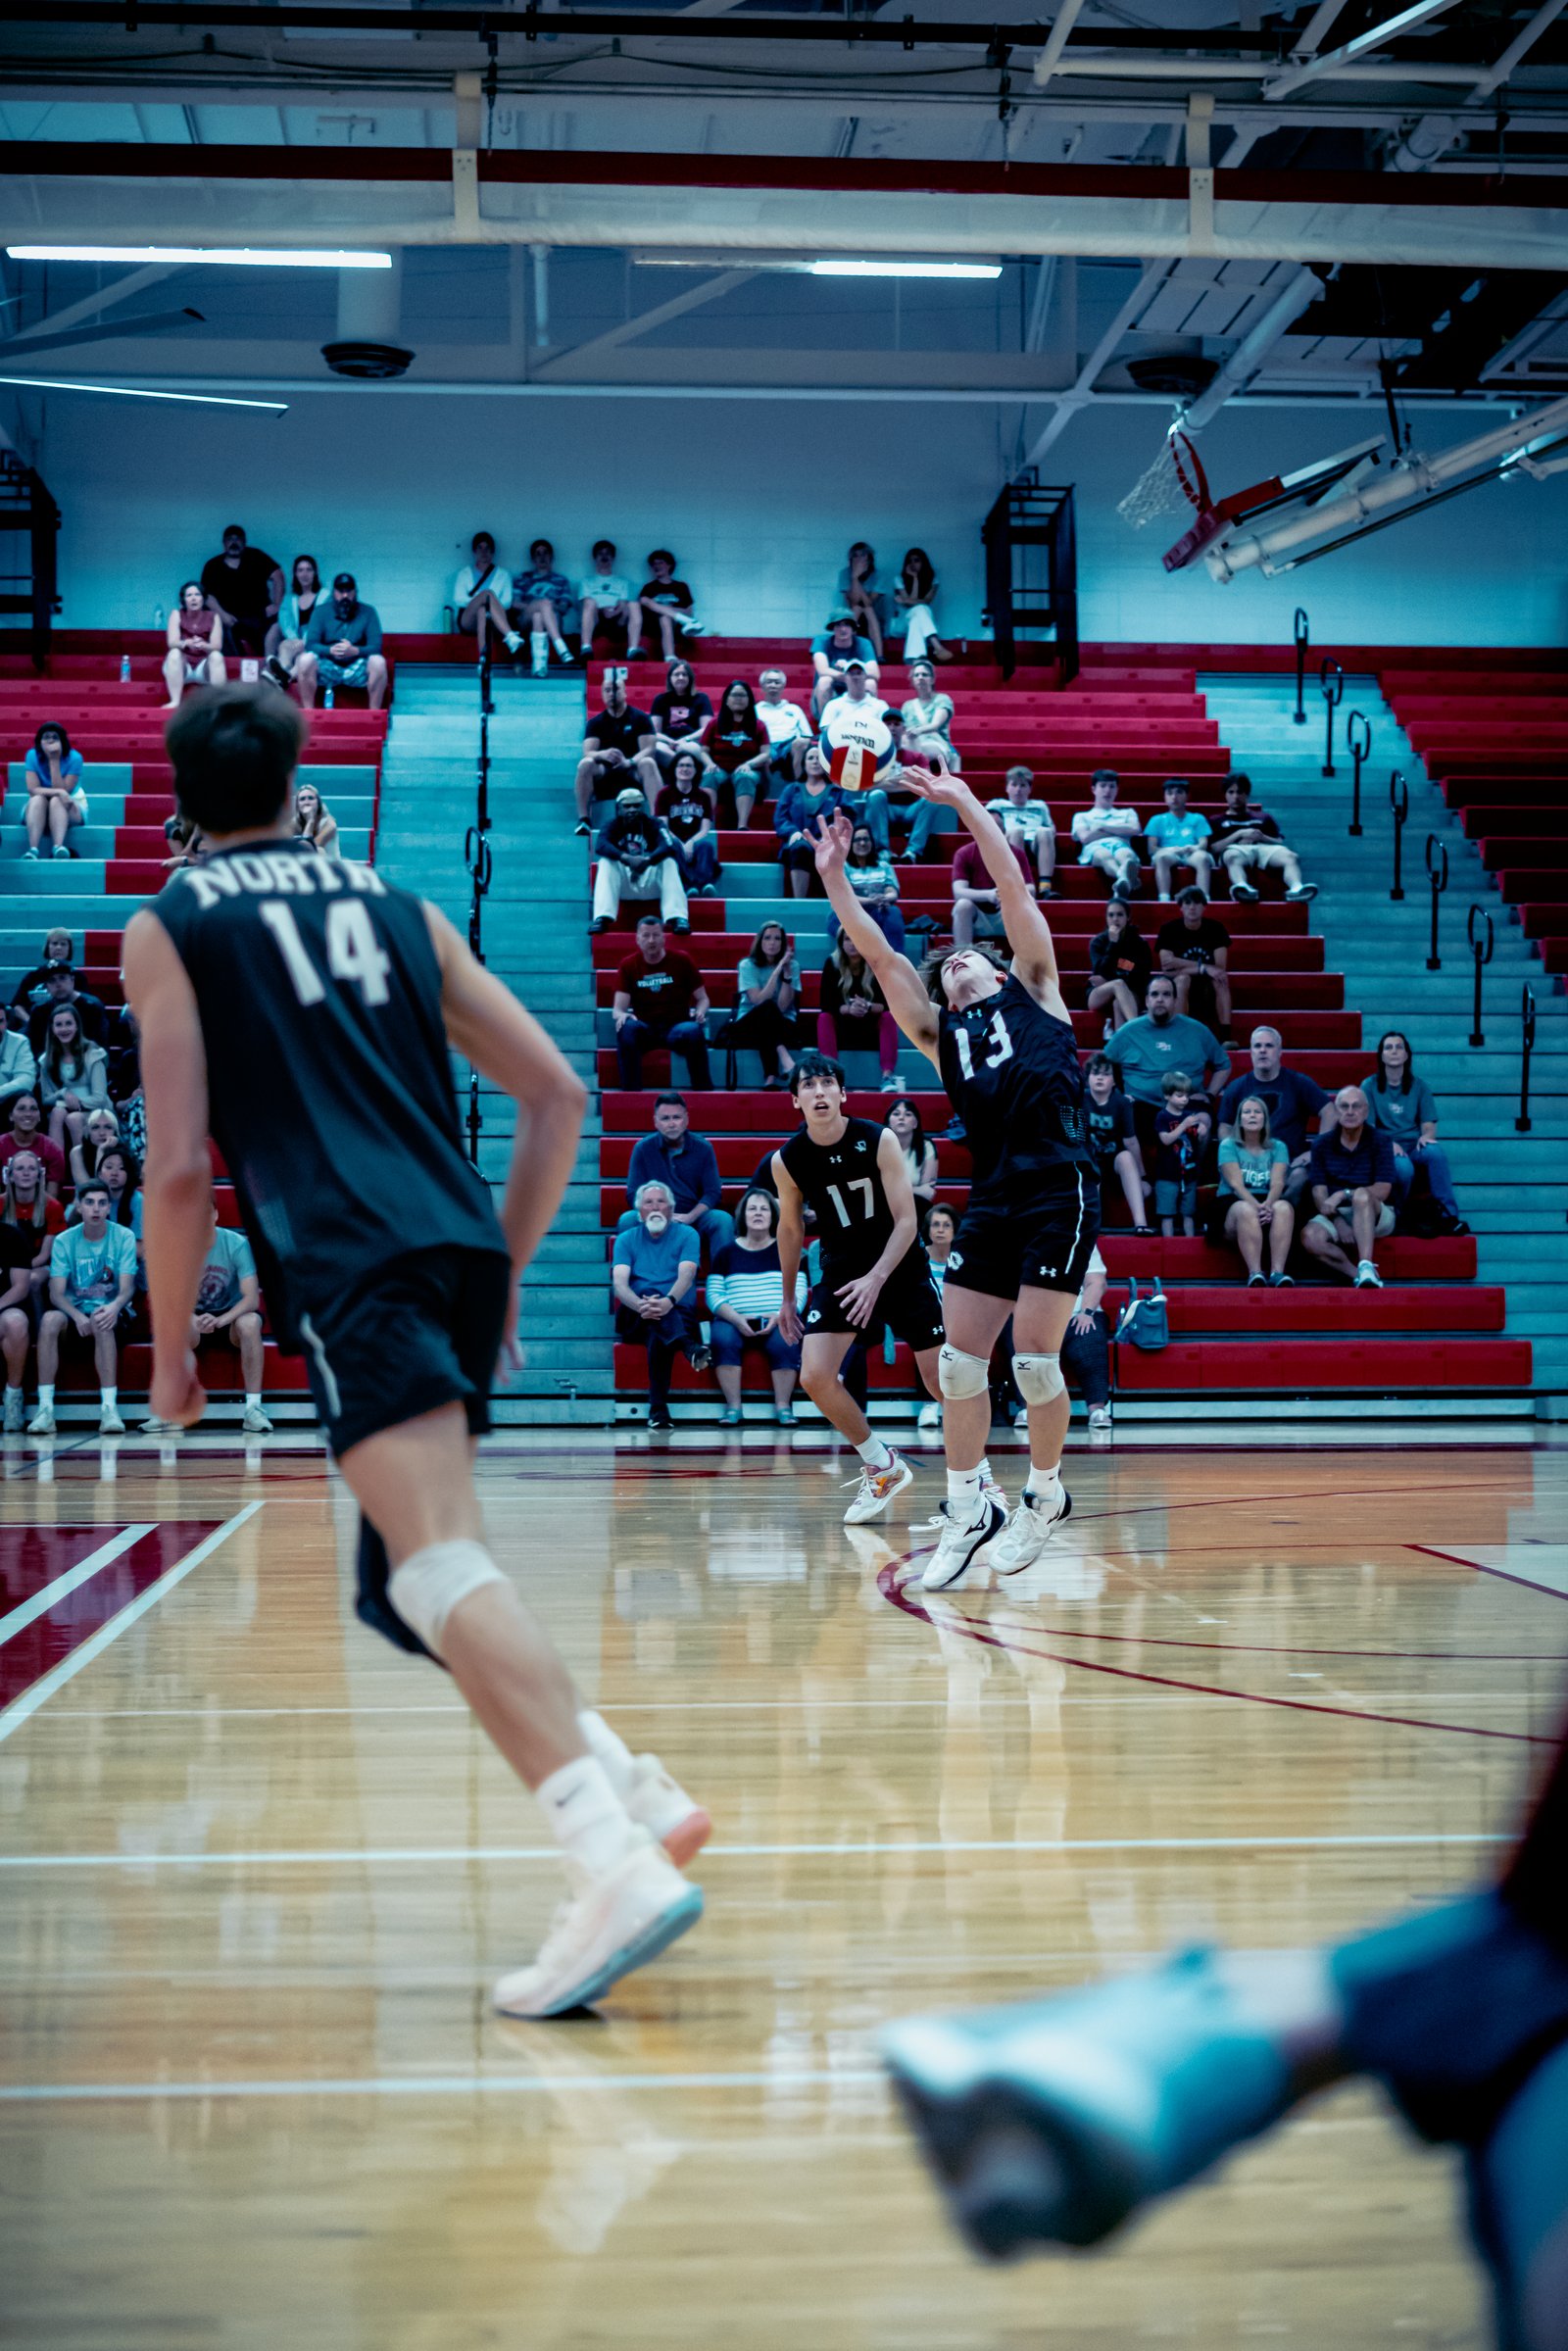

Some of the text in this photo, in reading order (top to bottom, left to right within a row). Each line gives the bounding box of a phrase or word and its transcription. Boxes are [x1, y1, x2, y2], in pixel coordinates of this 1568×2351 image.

[184, 851, 387, 911] NORTH
[259, 898, 391, 1007] 14
[636, 975, 674, 989] VOLLEYBALL
[955, 1009, 1014, 1081] 13
[825, 1176, 875, 1229] 17
